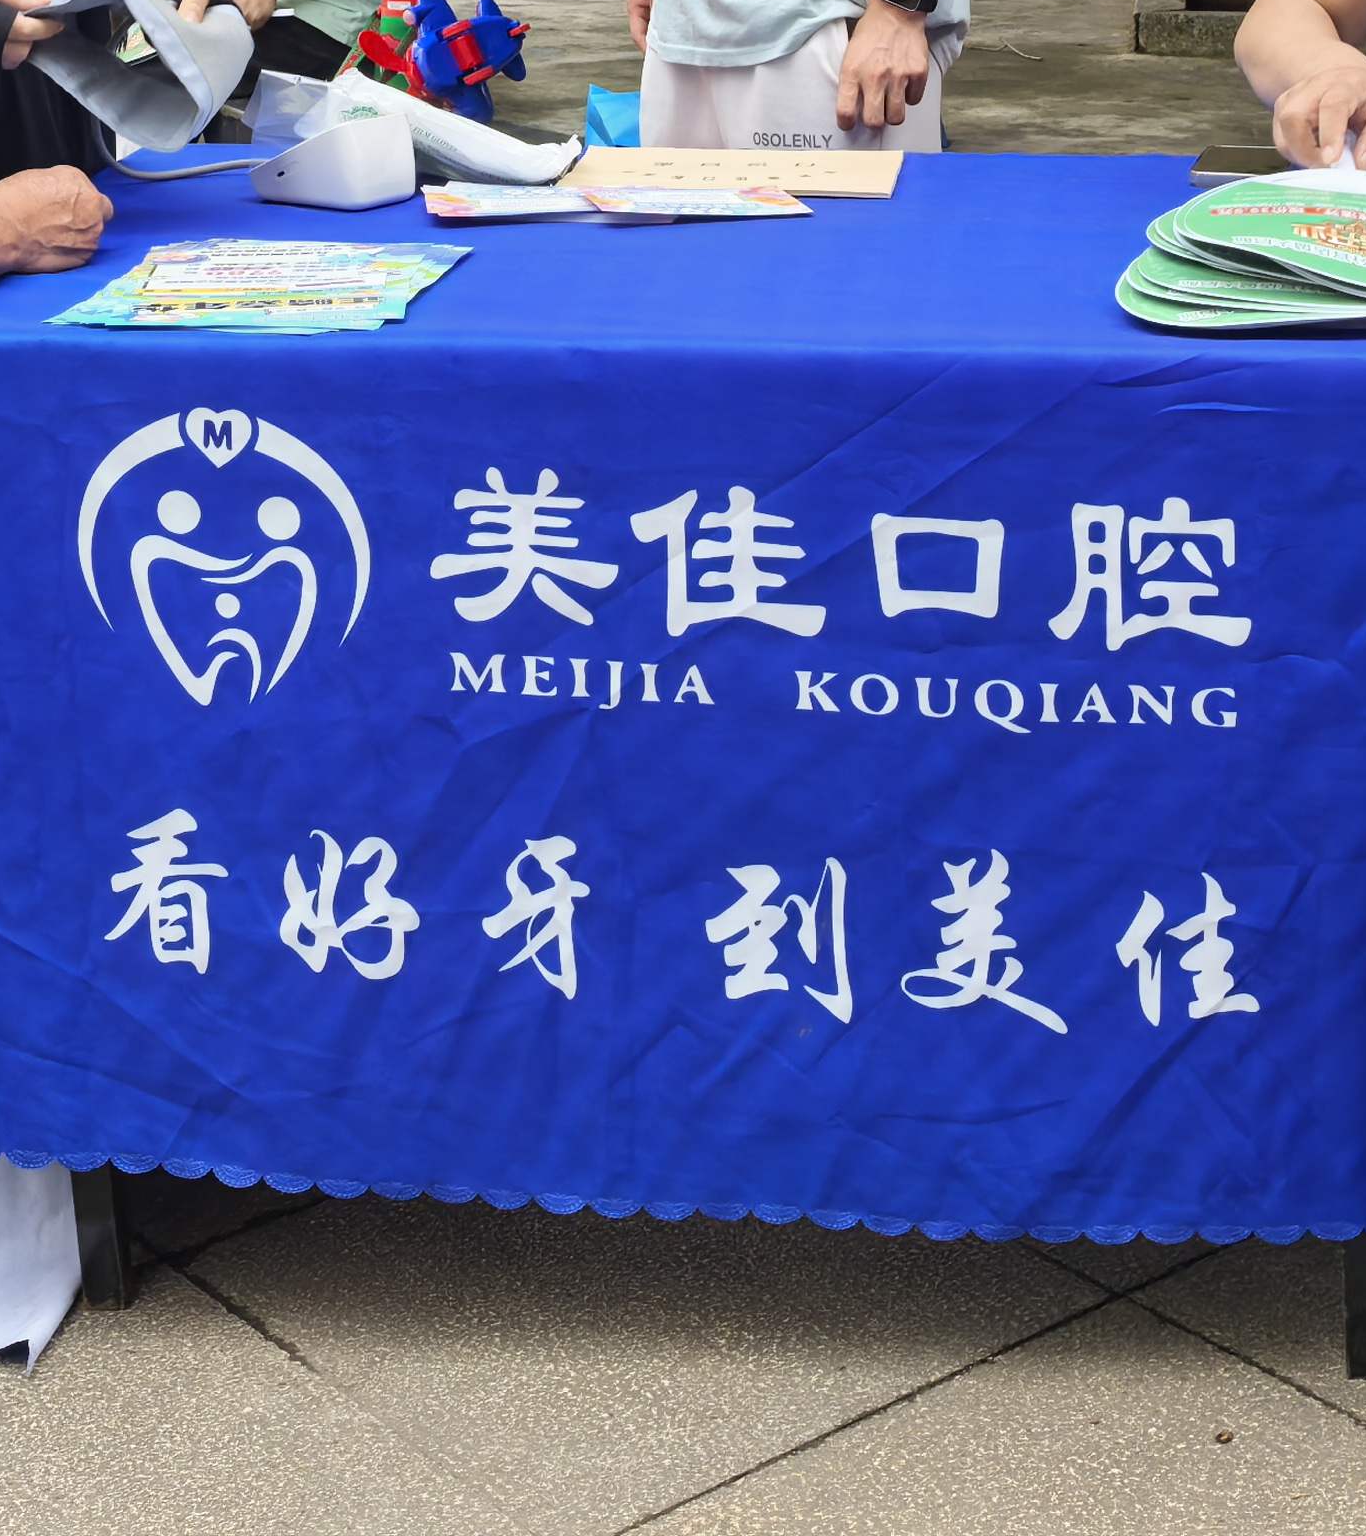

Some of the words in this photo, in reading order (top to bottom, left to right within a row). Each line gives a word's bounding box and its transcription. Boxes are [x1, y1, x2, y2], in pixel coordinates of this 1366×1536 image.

[203, 419, 233, 450] M
[430, 466, 1253, 651] 美佳口腔
[449, 651, 717, 710] MEIJIA
[794, 671, 1238, 734] KOUQIANG
[104, 808, 592, 1000] 看好牙
[704, 849, 1260, 1035] 到美佳
